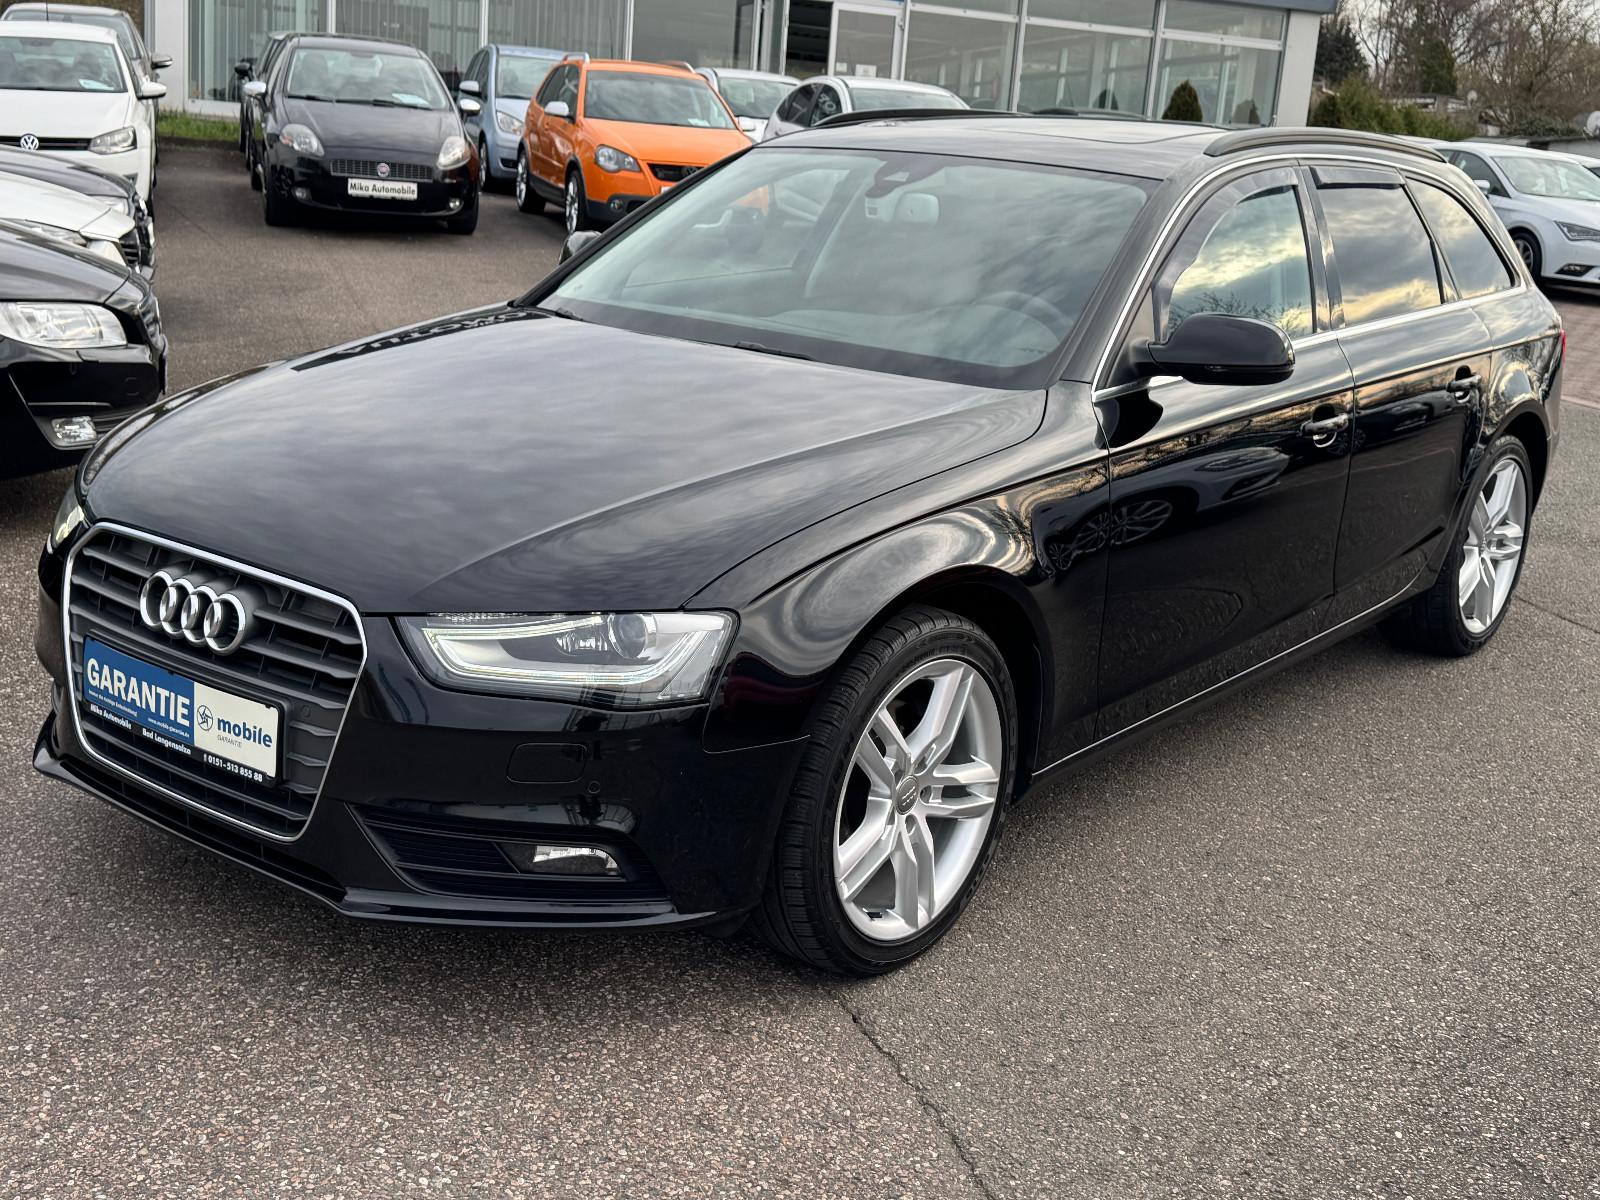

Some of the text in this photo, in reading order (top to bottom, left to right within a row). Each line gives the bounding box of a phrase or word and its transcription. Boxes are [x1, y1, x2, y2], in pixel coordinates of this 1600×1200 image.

[349, 182, 416, 195] Mika Automobile
[87, 658, 190, 727] GARANTIE
[90, 703, 132, 730] Mika Automobile
[142, 728, 191, 755] Bad Langensalza
[217, 717, 273, 748] mobile
[217, 734, 242, 749] GARANTIE
[239, 766, 253, 779] 855
